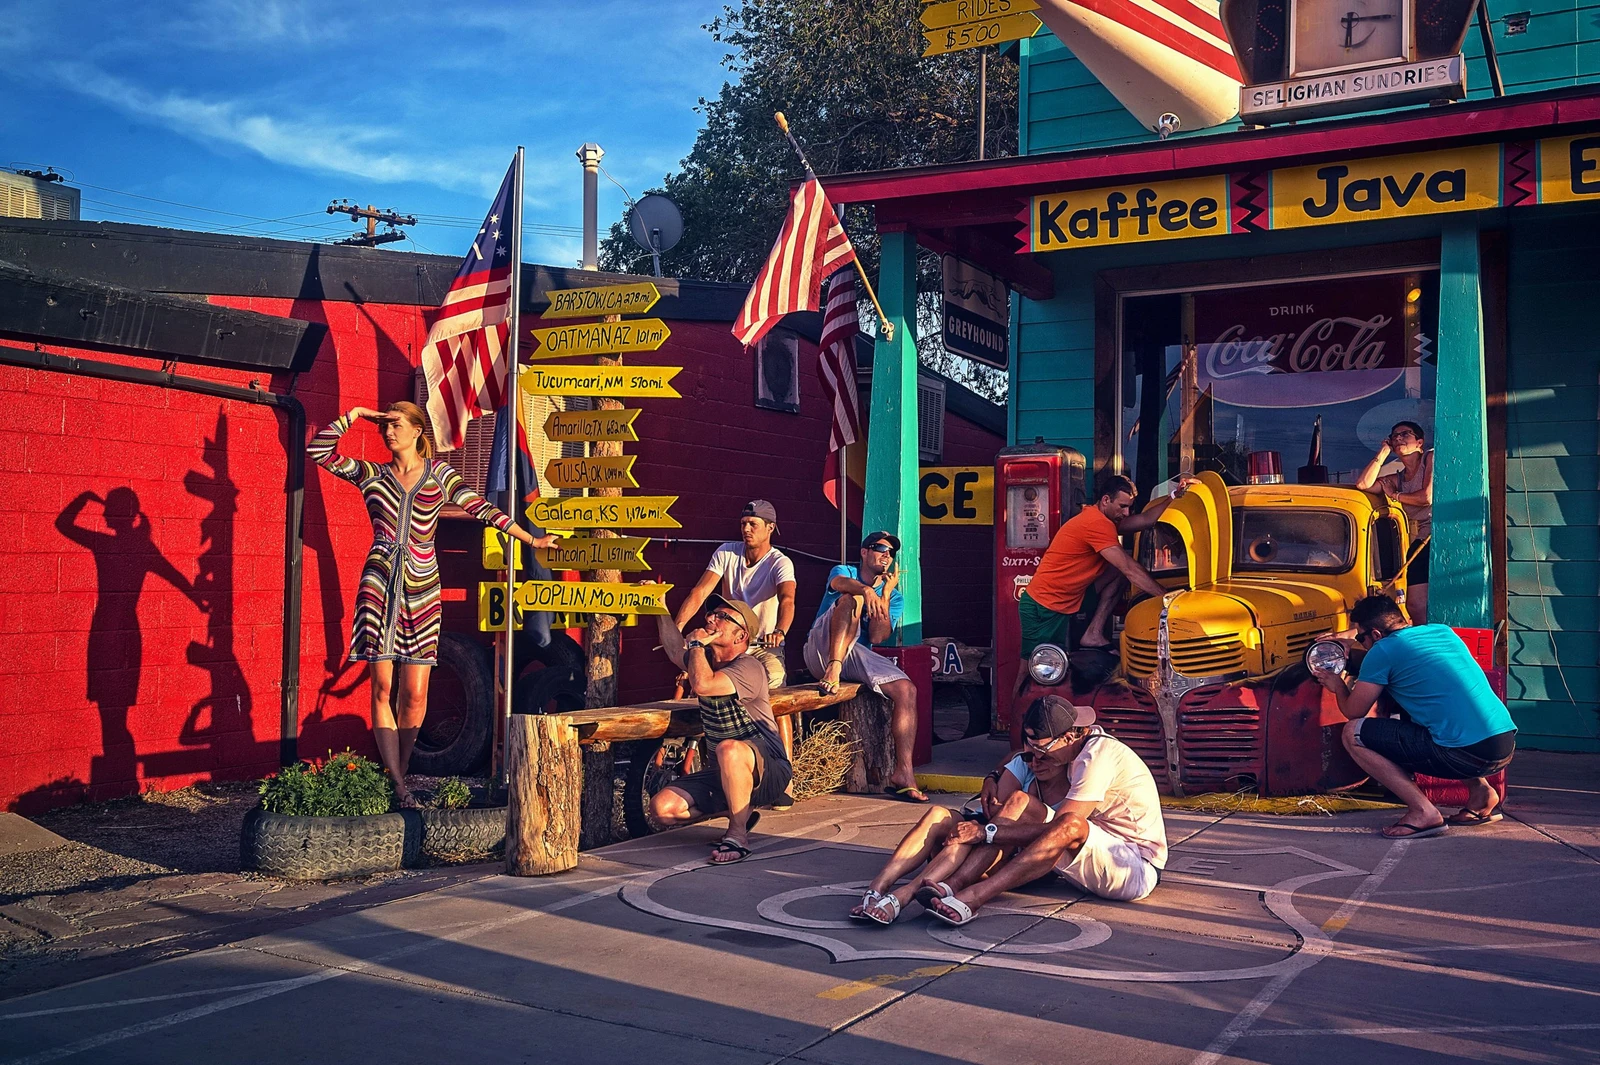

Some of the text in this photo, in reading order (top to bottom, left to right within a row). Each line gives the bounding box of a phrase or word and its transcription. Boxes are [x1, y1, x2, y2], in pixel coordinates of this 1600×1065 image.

[957, 0, 1011, 20] RIDES
[944, 23, 1000, 50] $5.00
[1253, 64, 1447, 107] SELIGMAN SUNDRIES
[1301, 164, 1466, 219] Java
[1039, 187, 1218, 246] Kaffee
[1268, 303, 1315, 316] DRINK
[948, 314, 1004, 353] GREYHOUND
[919, 471, 979, 519] CE
[1002, 556, 1040, 567] SIXTY-S
